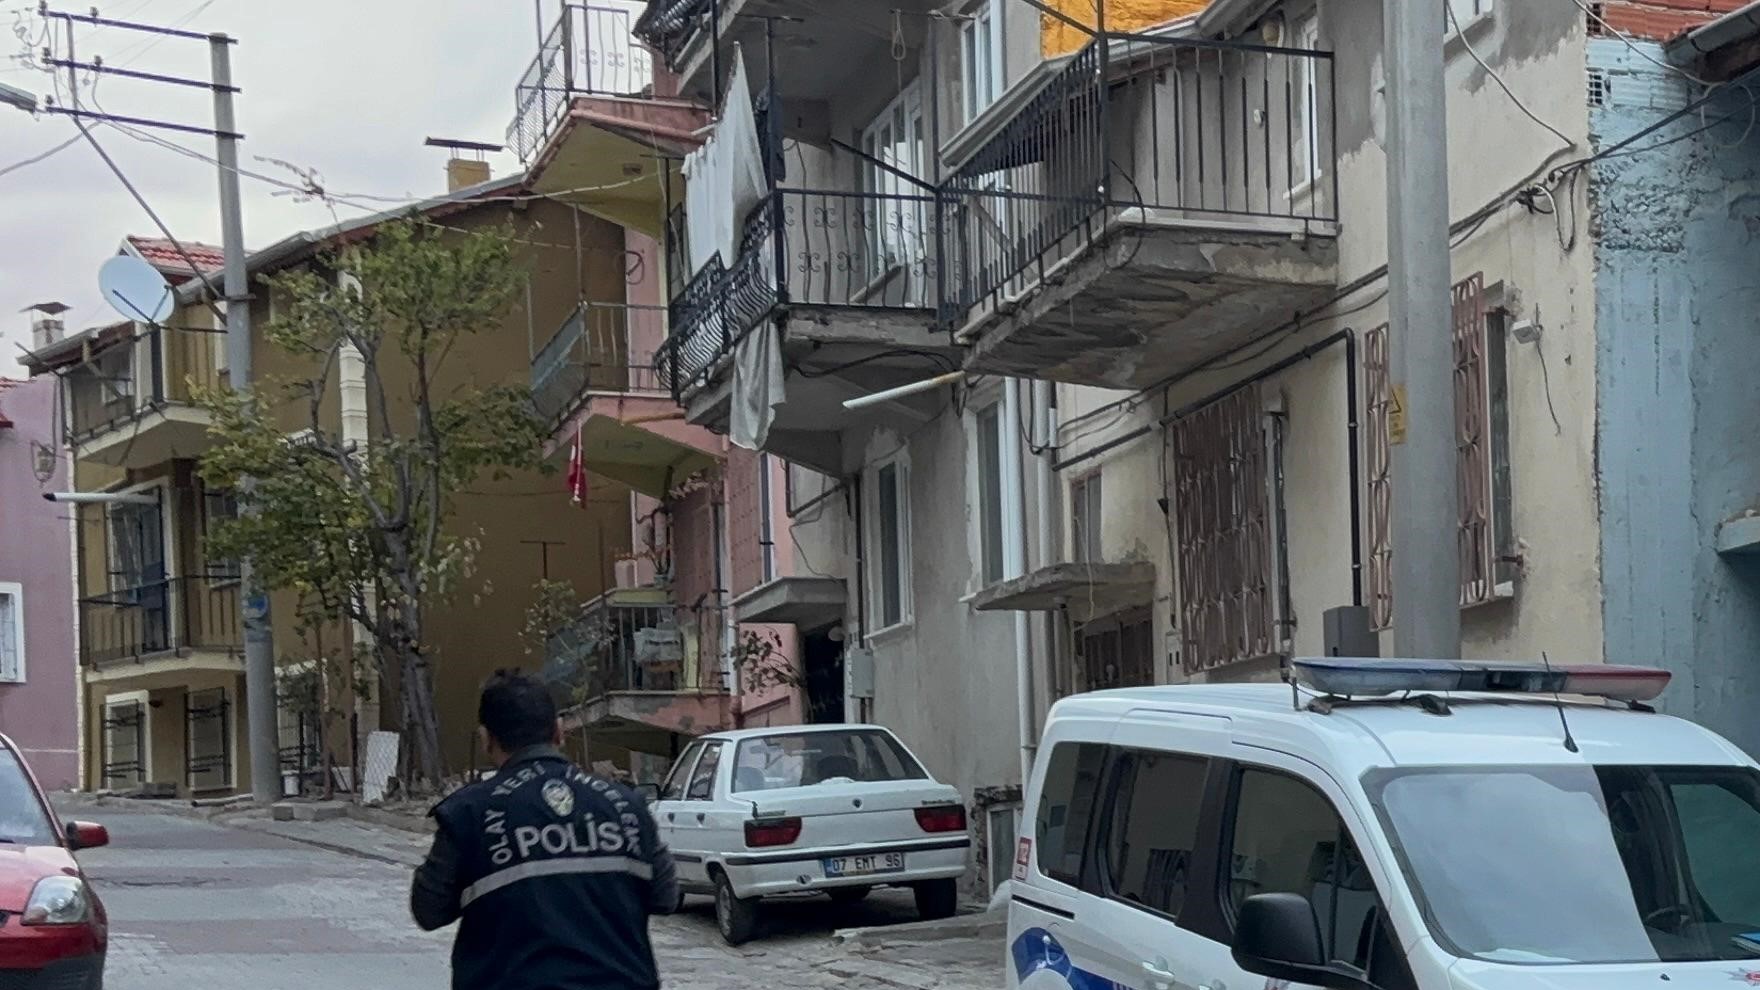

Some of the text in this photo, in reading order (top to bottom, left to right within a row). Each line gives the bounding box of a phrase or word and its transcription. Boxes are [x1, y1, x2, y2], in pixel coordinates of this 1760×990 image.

[484, 809, 513, 865] OLAY
[514, 812, 625, 858] POLİS
[831, 859, 847, 872] 07
[885, 853, 900, 867] 96
